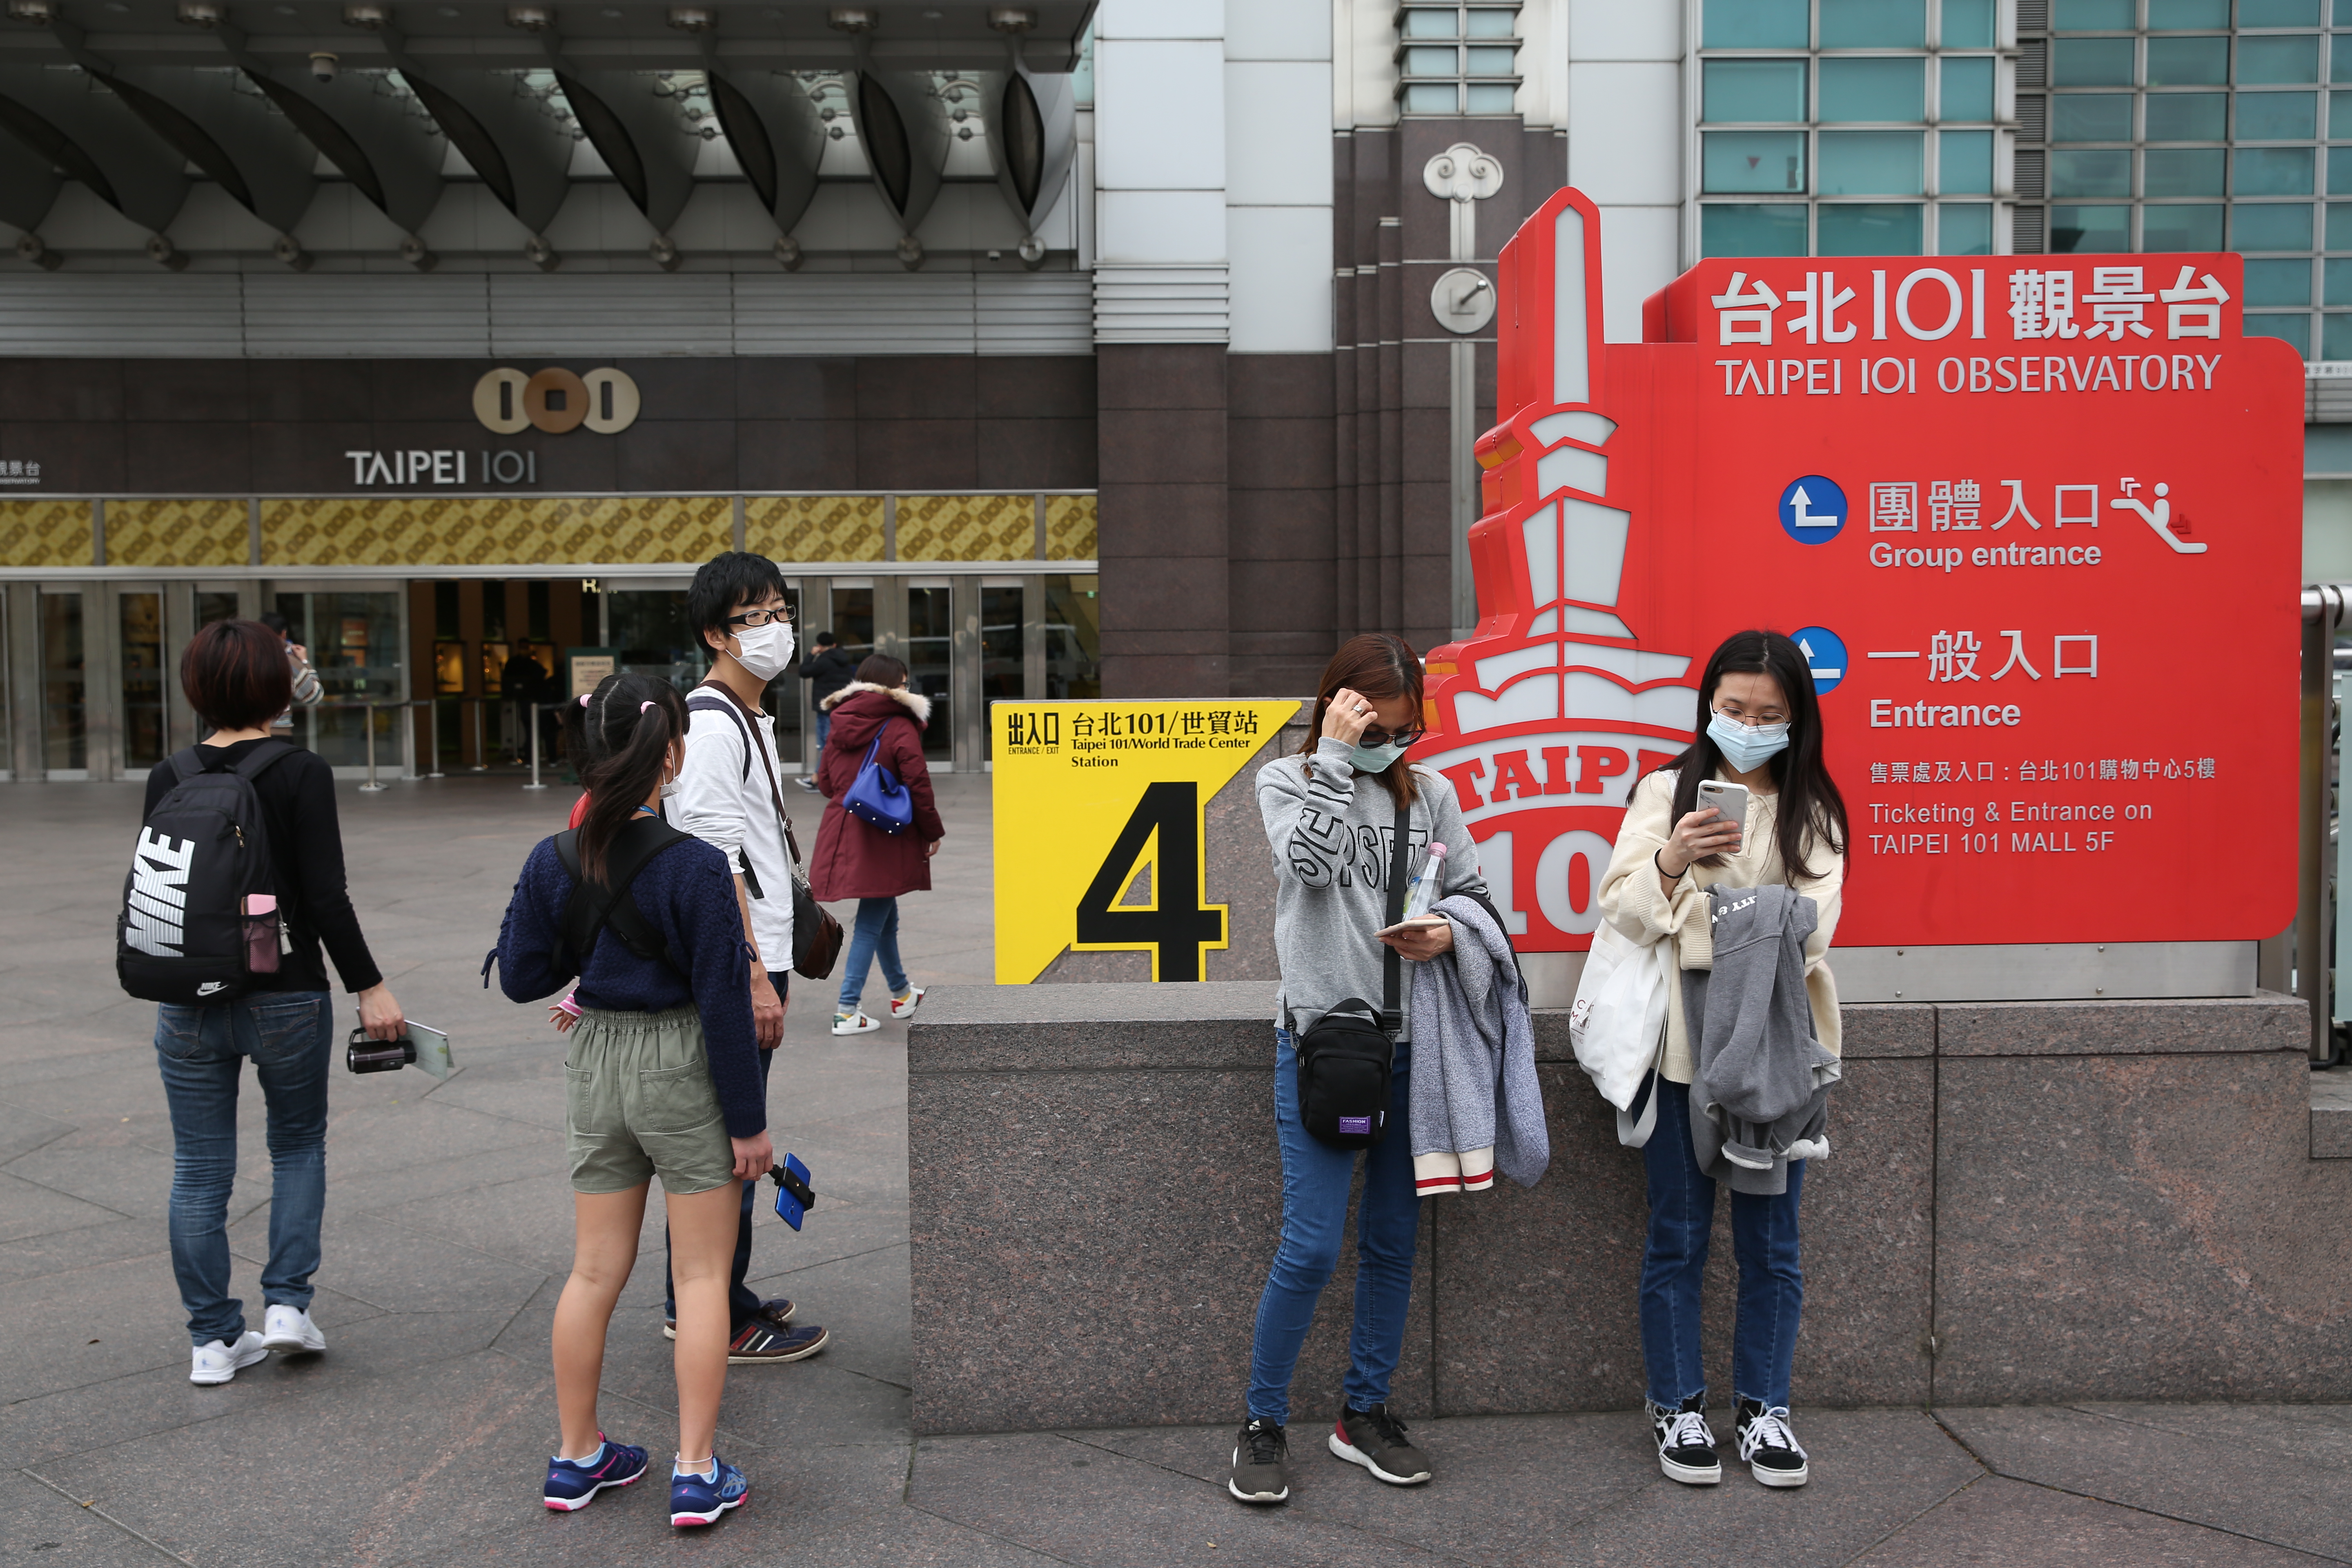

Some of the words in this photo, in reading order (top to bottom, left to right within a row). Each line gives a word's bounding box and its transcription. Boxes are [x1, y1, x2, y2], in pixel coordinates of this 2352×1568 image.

[1715, 359, 1841, 395] TAIPEI
[1938, 354, 2222, 393] OBSERVATORY
[345, 450, 466, 485] TAIPEI
[1869, 479, 2099, 532] 團體入口
[1869, 542, 1963, 572] Group
[1971, 541, 2101, 566] entrance
[1867, 630, 2098, 682] 一般入口
[1008, 713, 1059, 746] 出入口
[1071, 710, 1258, 736] 台北101/世貿站
[1870, 699, 2021, 728] Entrance
[1071, 737, 1106, 753] Taipei
[1172, 737, 1205, 749] Trade
[1209, 737, 1250, 748] Center
[1071, 755, 1118, 767] Station
[1439, 745, 1676, 813] TAIP
[1869, 803, 1974, 827] Ticketing
[1985, 802, 2000, 822] &
[2011, 801, 2115, 822] Entrance
[2125, 804, 2152, 820] on
[1869, 833, 1948, 855] TAIPEI
[1960, 833, 1998, 853] 101
[2011, 832, 2077, 853] MALL
[2085, 831, 2115, 851] 5F
[125, 825, 196, 957] NIKE
[1076, 782, 1222, 982] 4
[201, 981, 221, 990] NIKE
